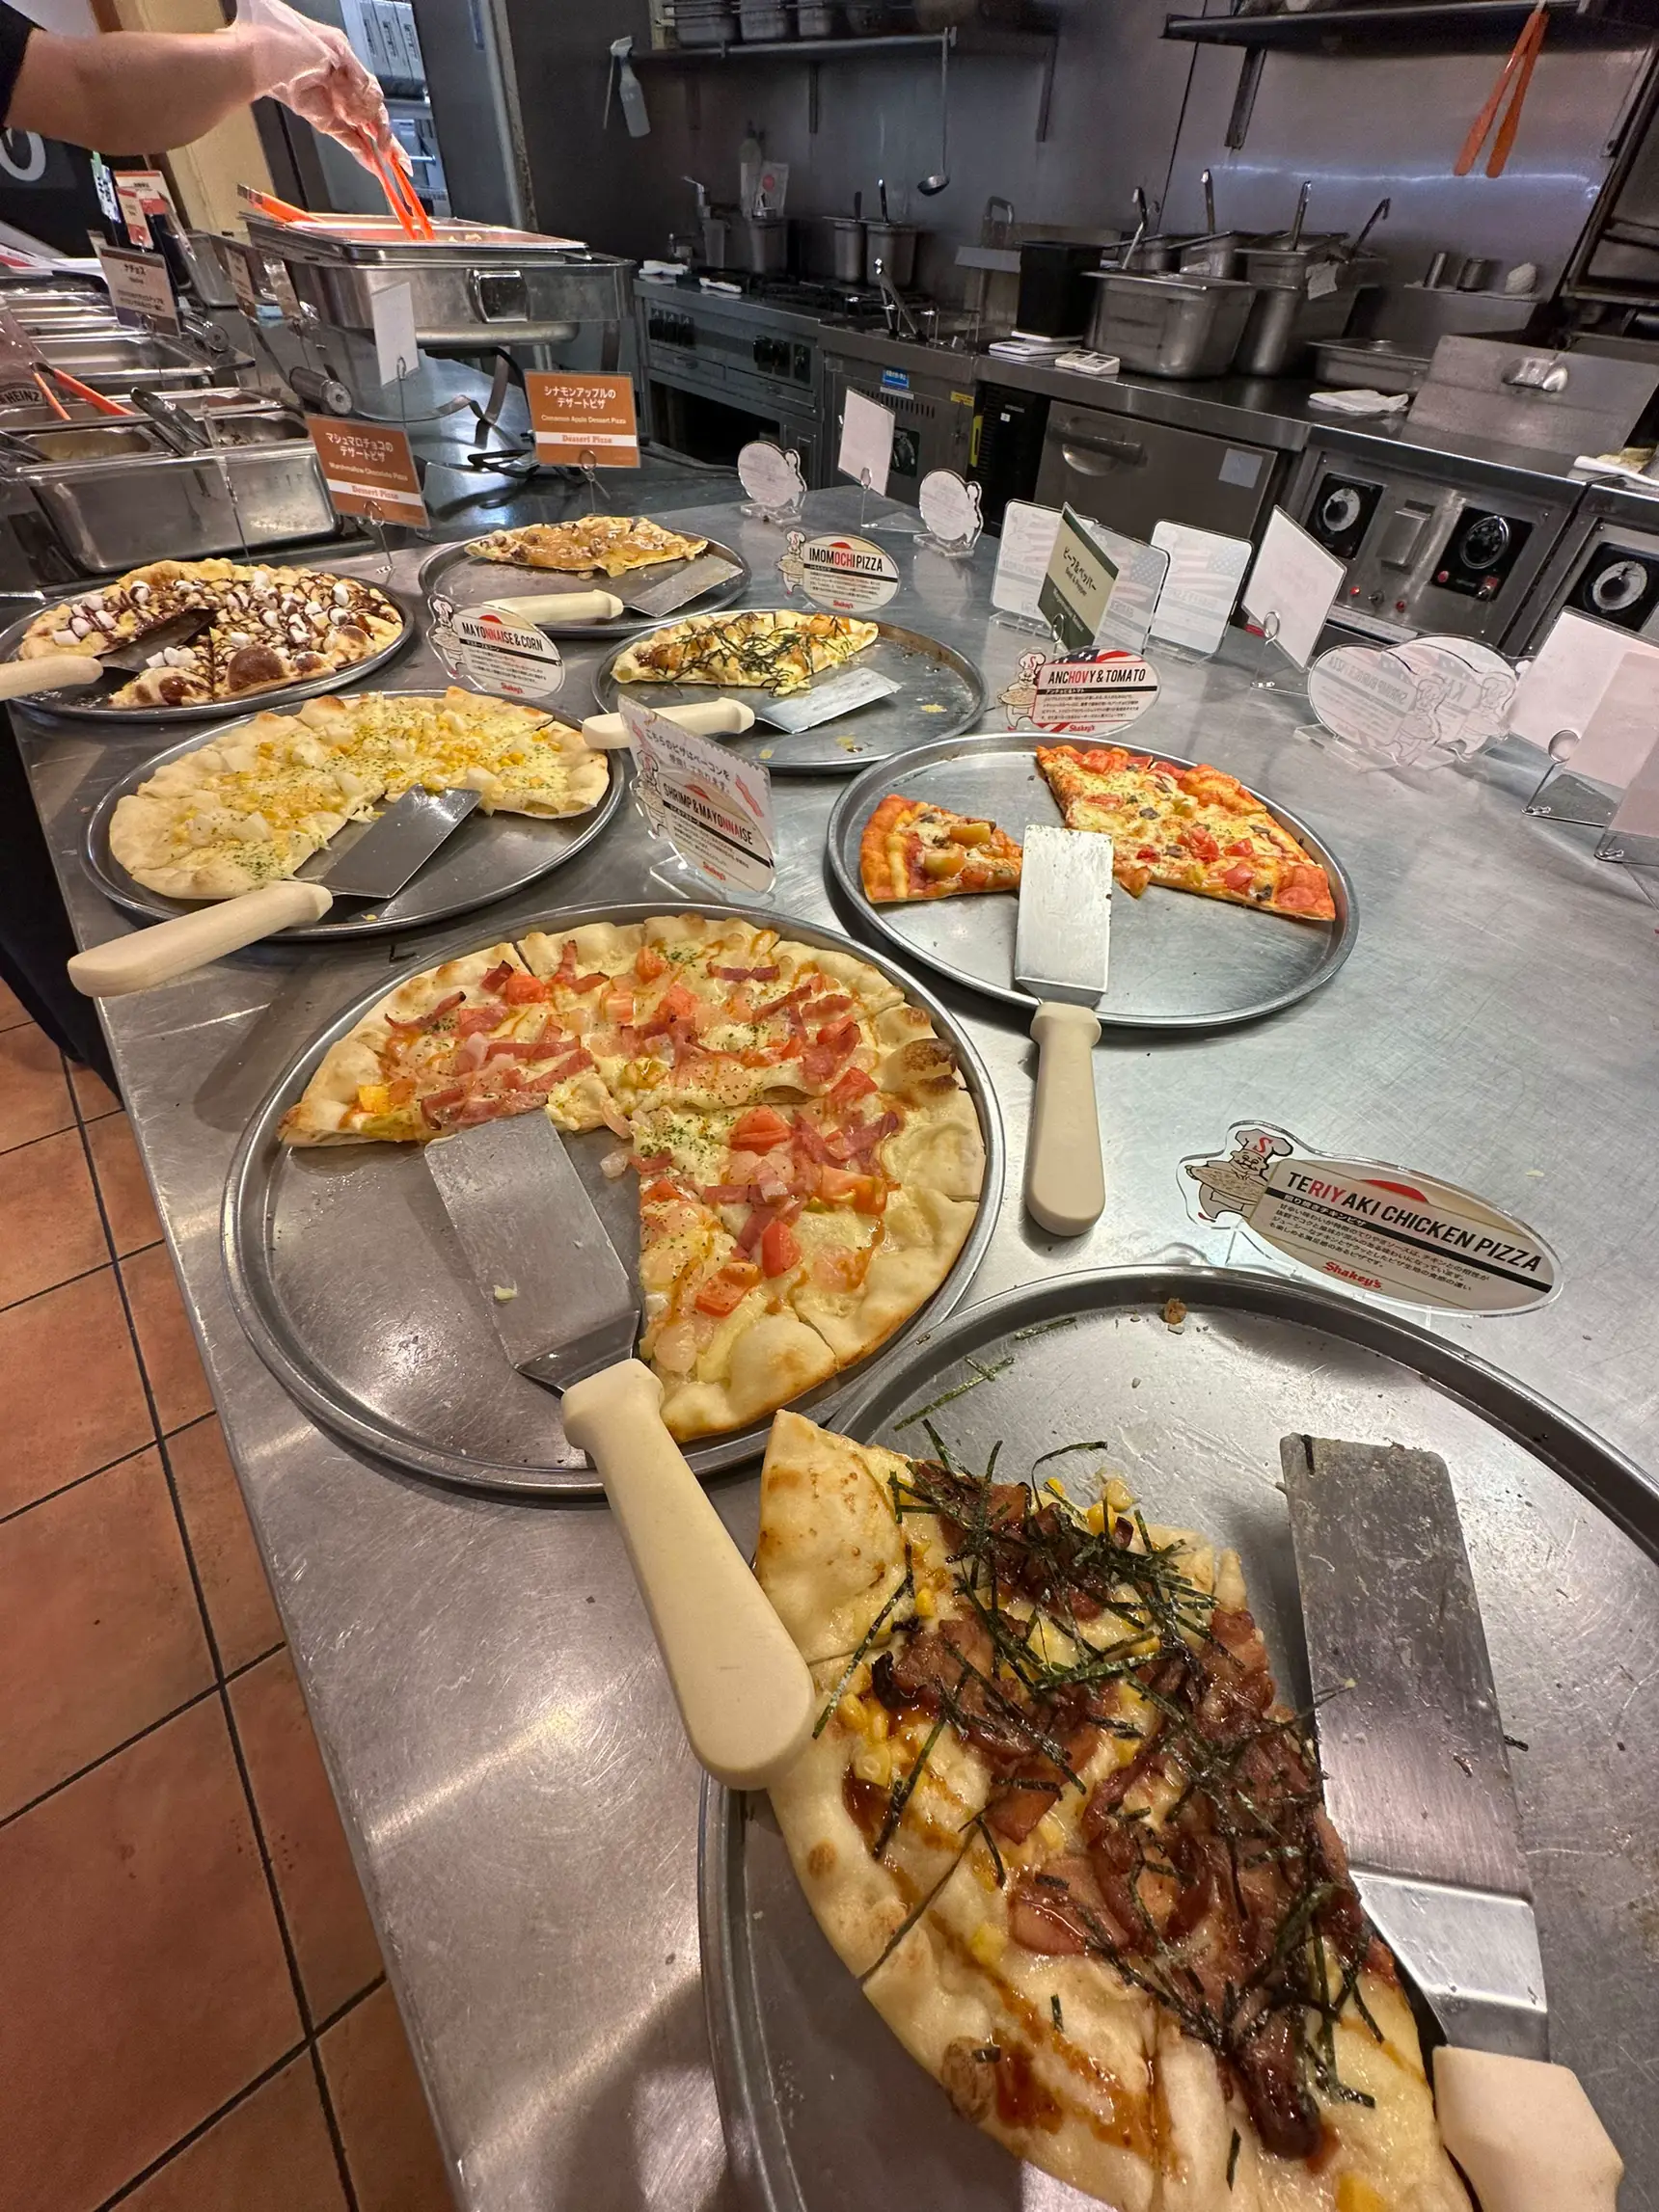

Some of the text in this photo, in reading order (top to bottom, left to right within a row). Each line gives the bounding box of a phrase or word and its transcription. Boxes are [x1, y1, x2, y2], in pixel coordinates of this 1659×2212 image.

[4, 390, 40, 404] HEINZ
[544, 386, 616, 399] シナモンアップルの
[557, 396, 606, 410] デザートピザ
[325, 432, 394, 453] マシュマロチョコの
[562, 435, 590, 444] Dessert
[340, 445, 386, 463] デザートピザ
[809, 547, 884, 572] IMOMOCHI PIZZA
[461, 622, 516, 646] MAYONNAISE
[514, 633, 522, 646] &
[521, 634, 544, 652] CORN
[1047, 668, 1146, 685] ANCHOVY & TOMATO
[663, 782, 693, 808] SHRIMP
[692, 798, 700, 815] &
[698, 804, 753, 846] MAYONNAISE
[1284, 1194, 1368, 1227] 照り焼きチキンピザ
[1287, 1172, 1542, 1272] TERIYAKI CHICKEN PIZZA
[1323, 1261, 1382, 1289] Shakey's
